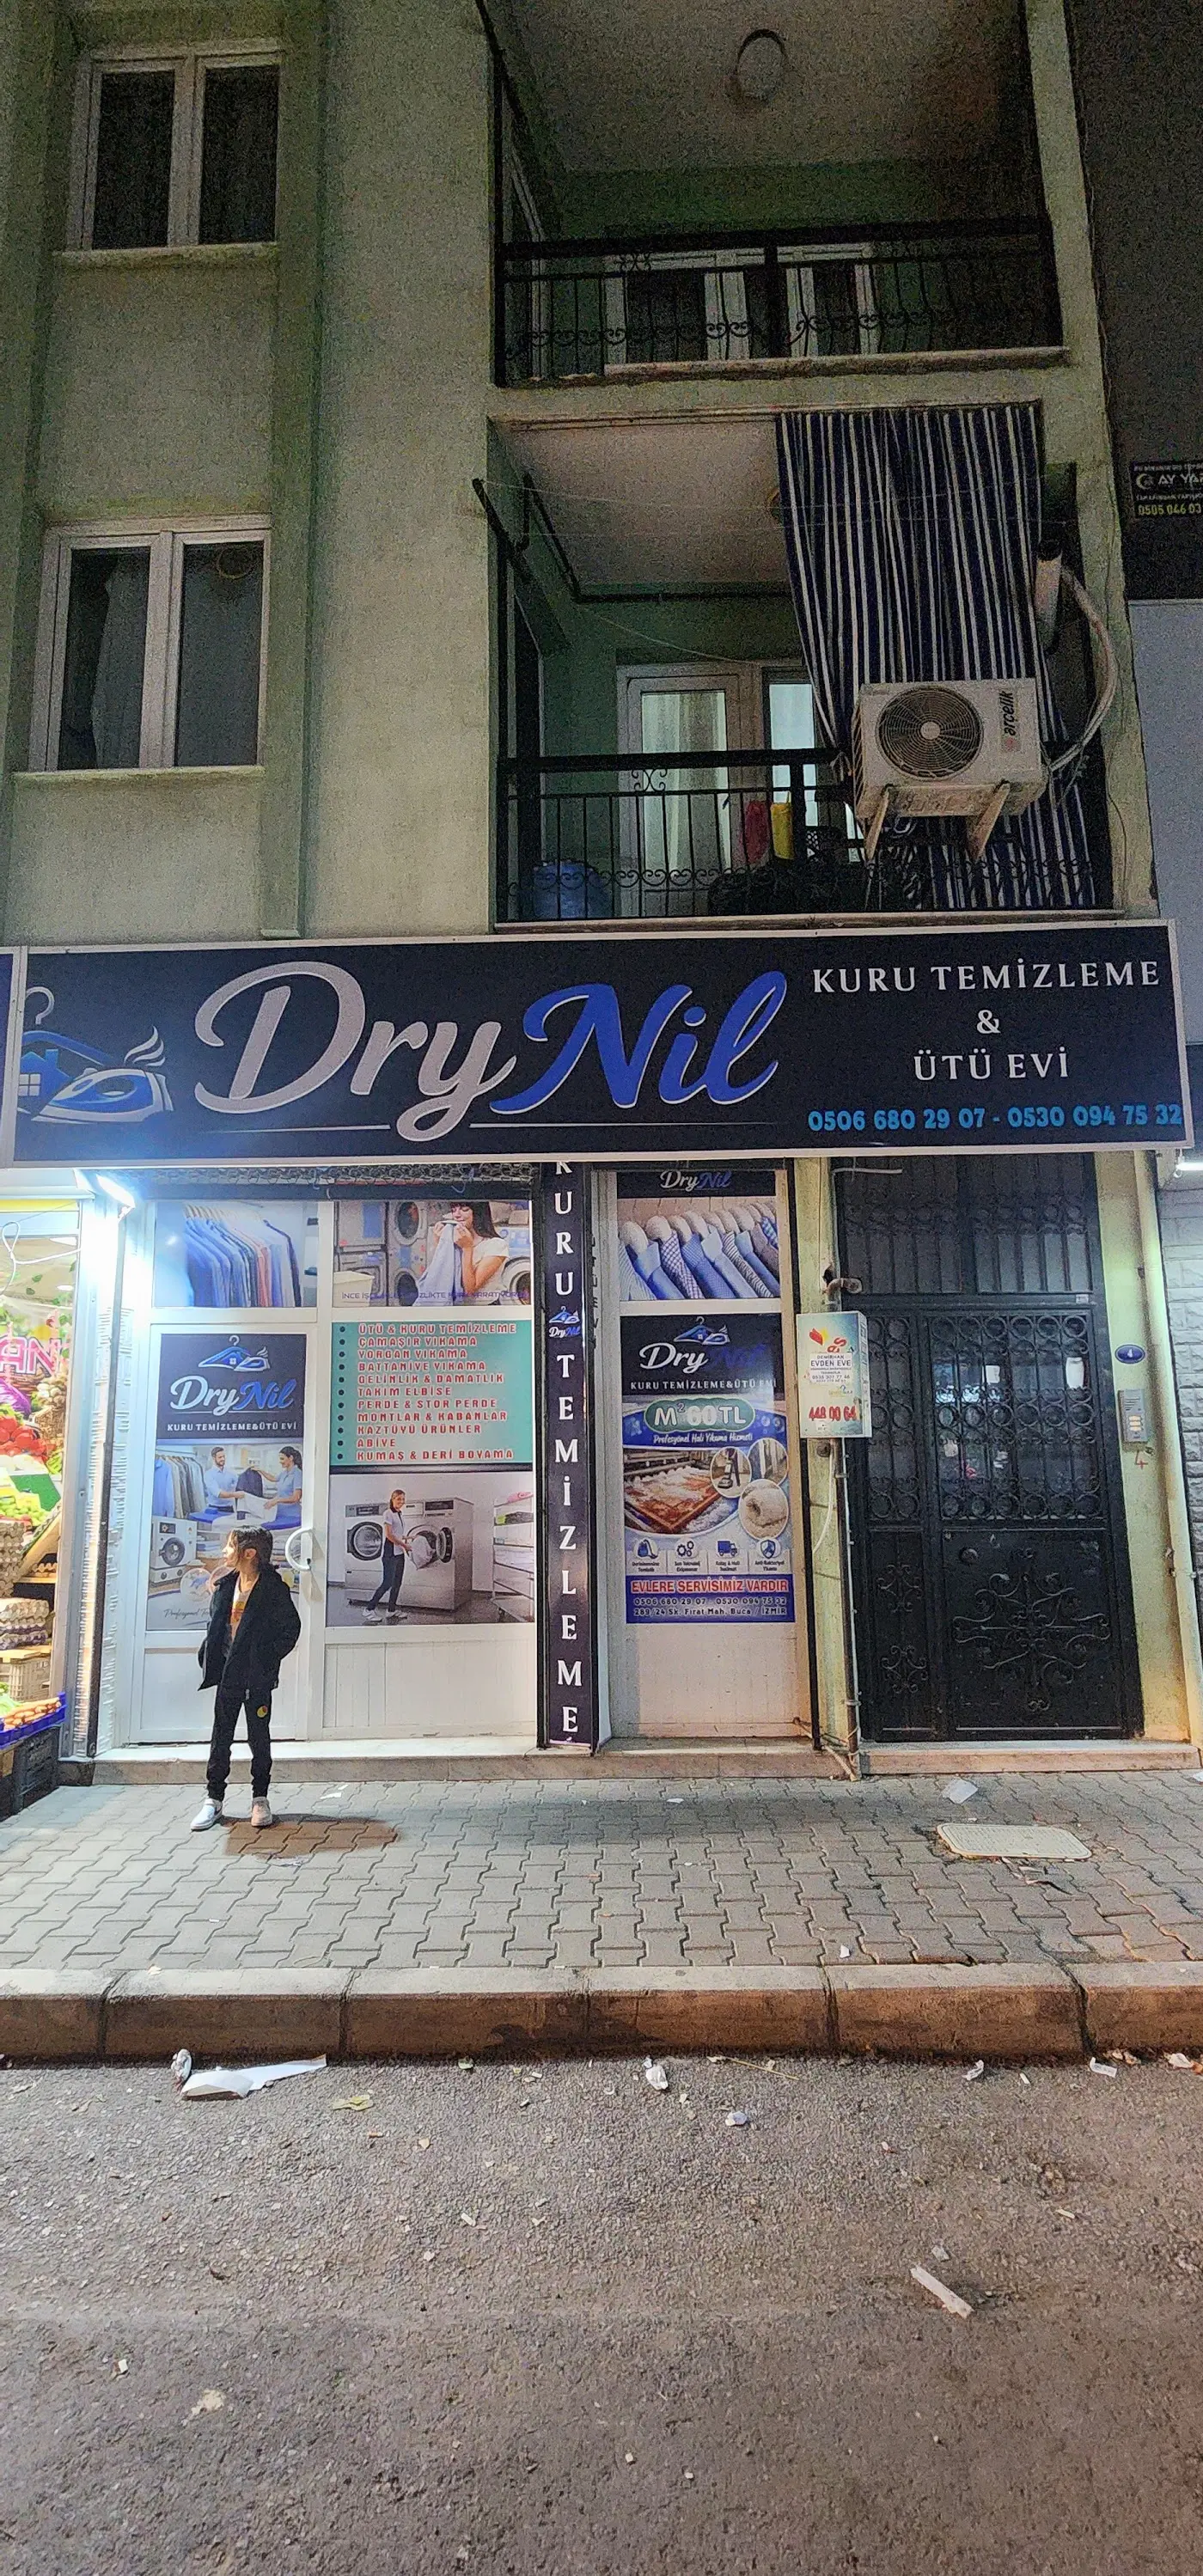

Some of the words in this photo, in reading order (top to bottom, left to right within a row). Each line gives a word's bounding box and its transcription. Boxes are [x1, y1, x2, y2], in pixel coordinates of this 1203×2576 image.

[813, 967, 916, 993] KURU
[931, 958, 1159, 991] TEMİZLEME
[976, 1010, 1001, 1035] &
[913, 1048, 992, 1081] ÜTÜ
[1008, 1046, 1069, 1078] EVİ
[808, 1110, 865, 1132] 0506
[874, 1109, 915, 1131] 680
[924, 1108, 950, 1130] 29
[959, 1108, 986, 1128] 07
[1007, 1107, 1066, 1128] 0530
[1073, 1106, 1115, 1126] 094
[1122, 1105, 1148, 1126] 75
[1156, 1104, 1182, 1125] 32
[358, 1323, 384, 1335] ÜTÜ
[388, 1324, 396, 1334] &
[400, 1324, 436, 1334] KURU
[439, 1322, 517, 1334] TEMİZLEME
[357, 1337, 421, 1348] ÇAMAŞIR
[424, 1336, 478, 1347] YIKAMA
[357, 1349, 411, 1359] YORGAN
[415, 1348, 468, 1358] YIKAMA
[357, 1361, 430, 1372] BATTANİYE
[433, 1360, 486, 1371] YIKAMA
[357, 1373, 419, 1385] GELİNLİK
[423, 1375, 431, 1384] &
[436, 1373, 504, 1383] DAMATLIK
[631, 1381, 659, 1389] KURU
[357, 1387, 400, 1397] TAKIM
[405, 1385, 452, 1396] ELBİSE
[357, 1400, 400, 1410] PERDE
[404, 1400, 412, 1409] &
[417, 1399, 450, 1409] STOR
[455, 1398, 498, 1408] PERDE
[357, 1412, 421, 1422] MONTLAR
[425, 1412, 433, 1421] &
[437, 1411, 508, 1421] KABANLAR
[718, 1406, 746, 1425] TL
[167, 1423, 193, 1431] KURU
[281, 1421, 297, 1431] EVİ
[357, 1423, 417, 1435] KAZTÜYÜ
[421, 1423, 482, 1434] ÜRÜNLER
[356, 1437, 397, 1448] ABİYE
[356, 1450, 406, 1462] KUMAŞ
[409, 1450, 418, 1460] &
[422, 1449, 454, 1460] DERİ
[458, 1449, 514, 1460] BOYAMA
[555, 1354, 582, 1732] TEMİZLEME
[632, 1580, 675, 1593] EVLERE
[677, 1577, 743, 1593] SERVİSİMİZ
[746, 1579, 789, 1592] VARDIR
